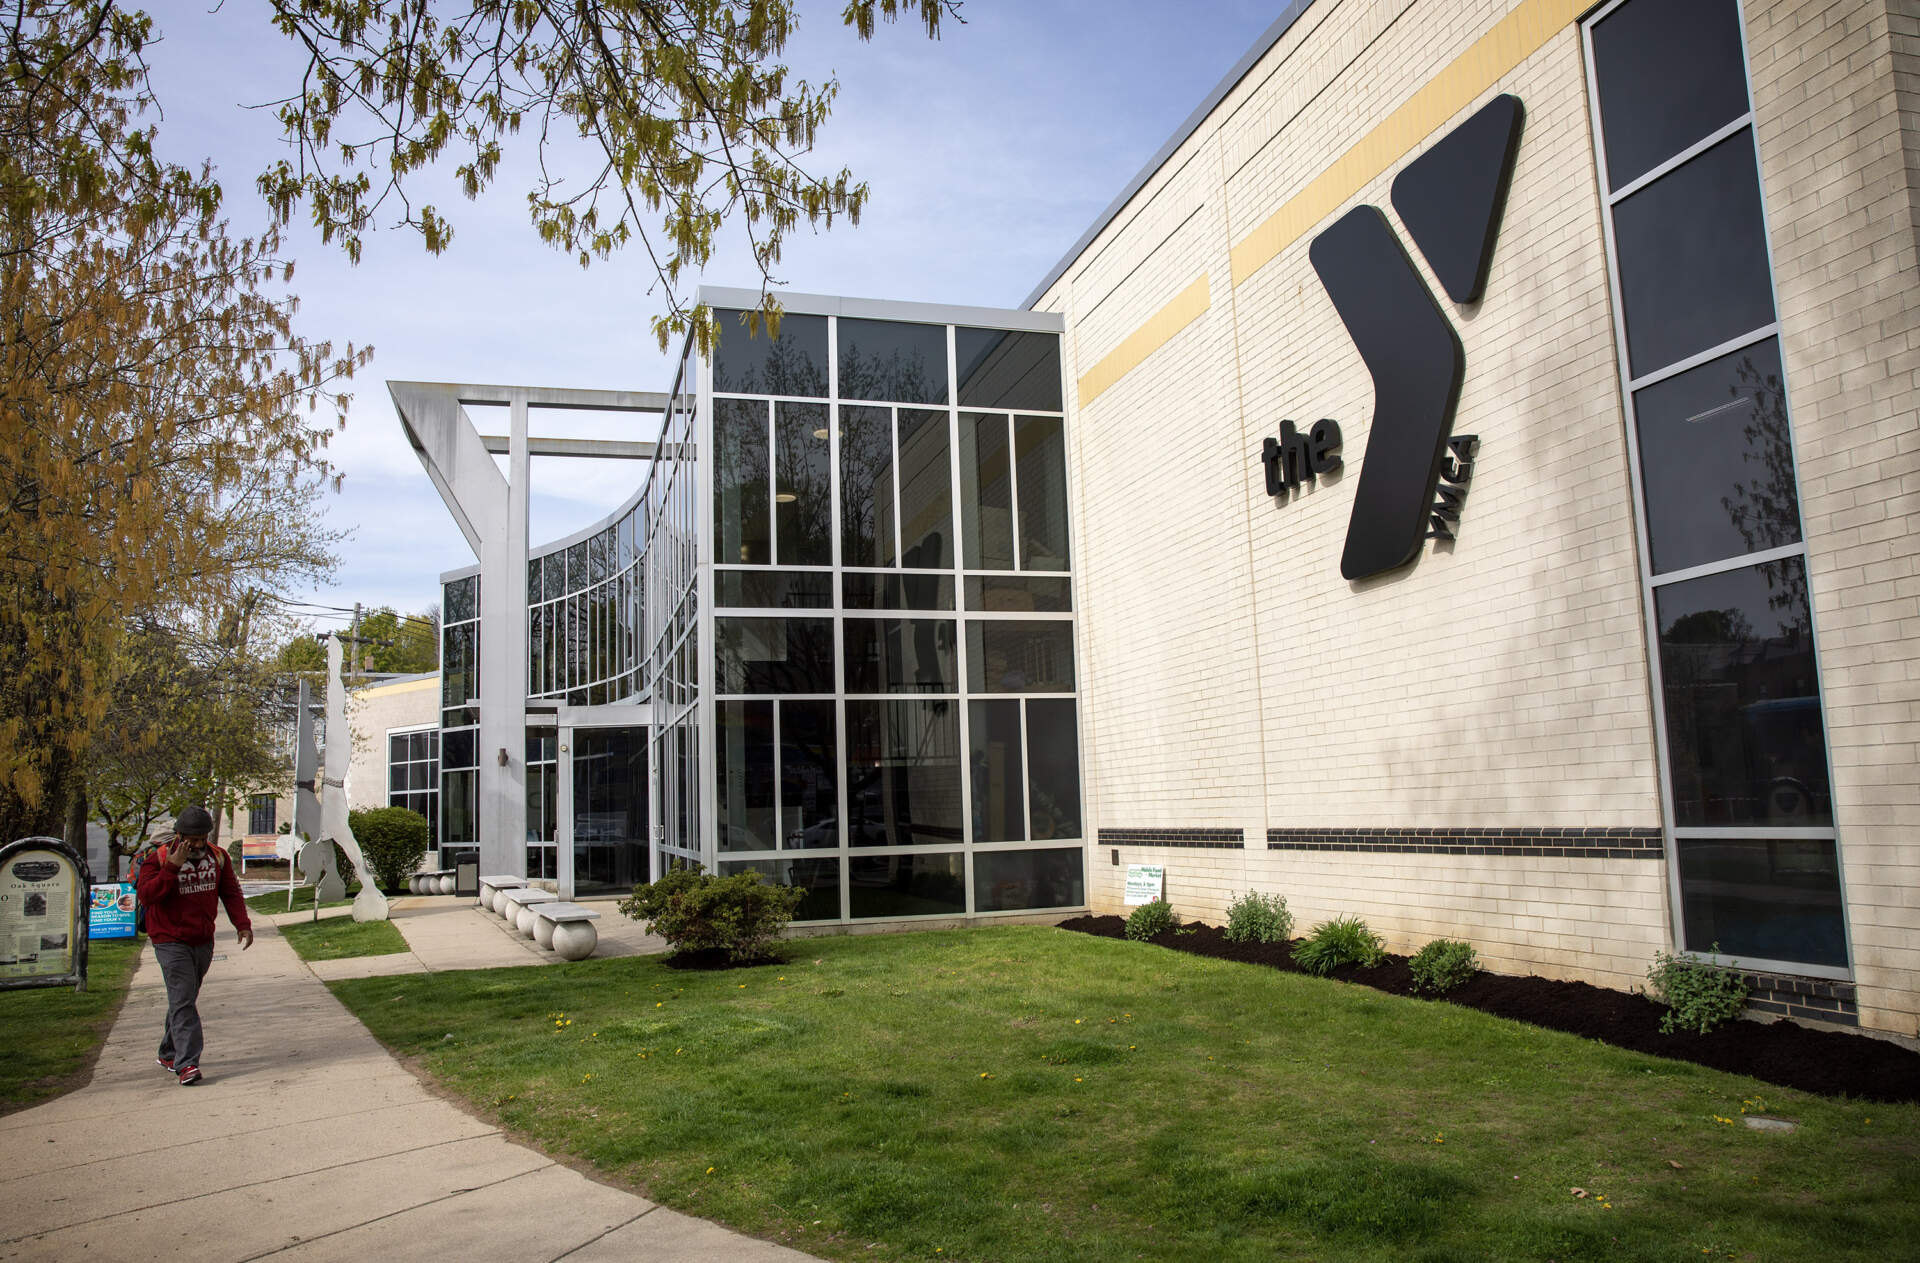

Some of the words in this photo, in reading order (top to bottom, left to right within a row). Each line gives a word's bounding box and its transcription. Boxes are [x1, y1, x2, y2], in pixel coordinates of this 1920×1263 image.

[1262, 418, 1343, 497] the
[1424, 434, 1479, 541] YMCA
[179, 883, 216, 895] UNLIMITED
